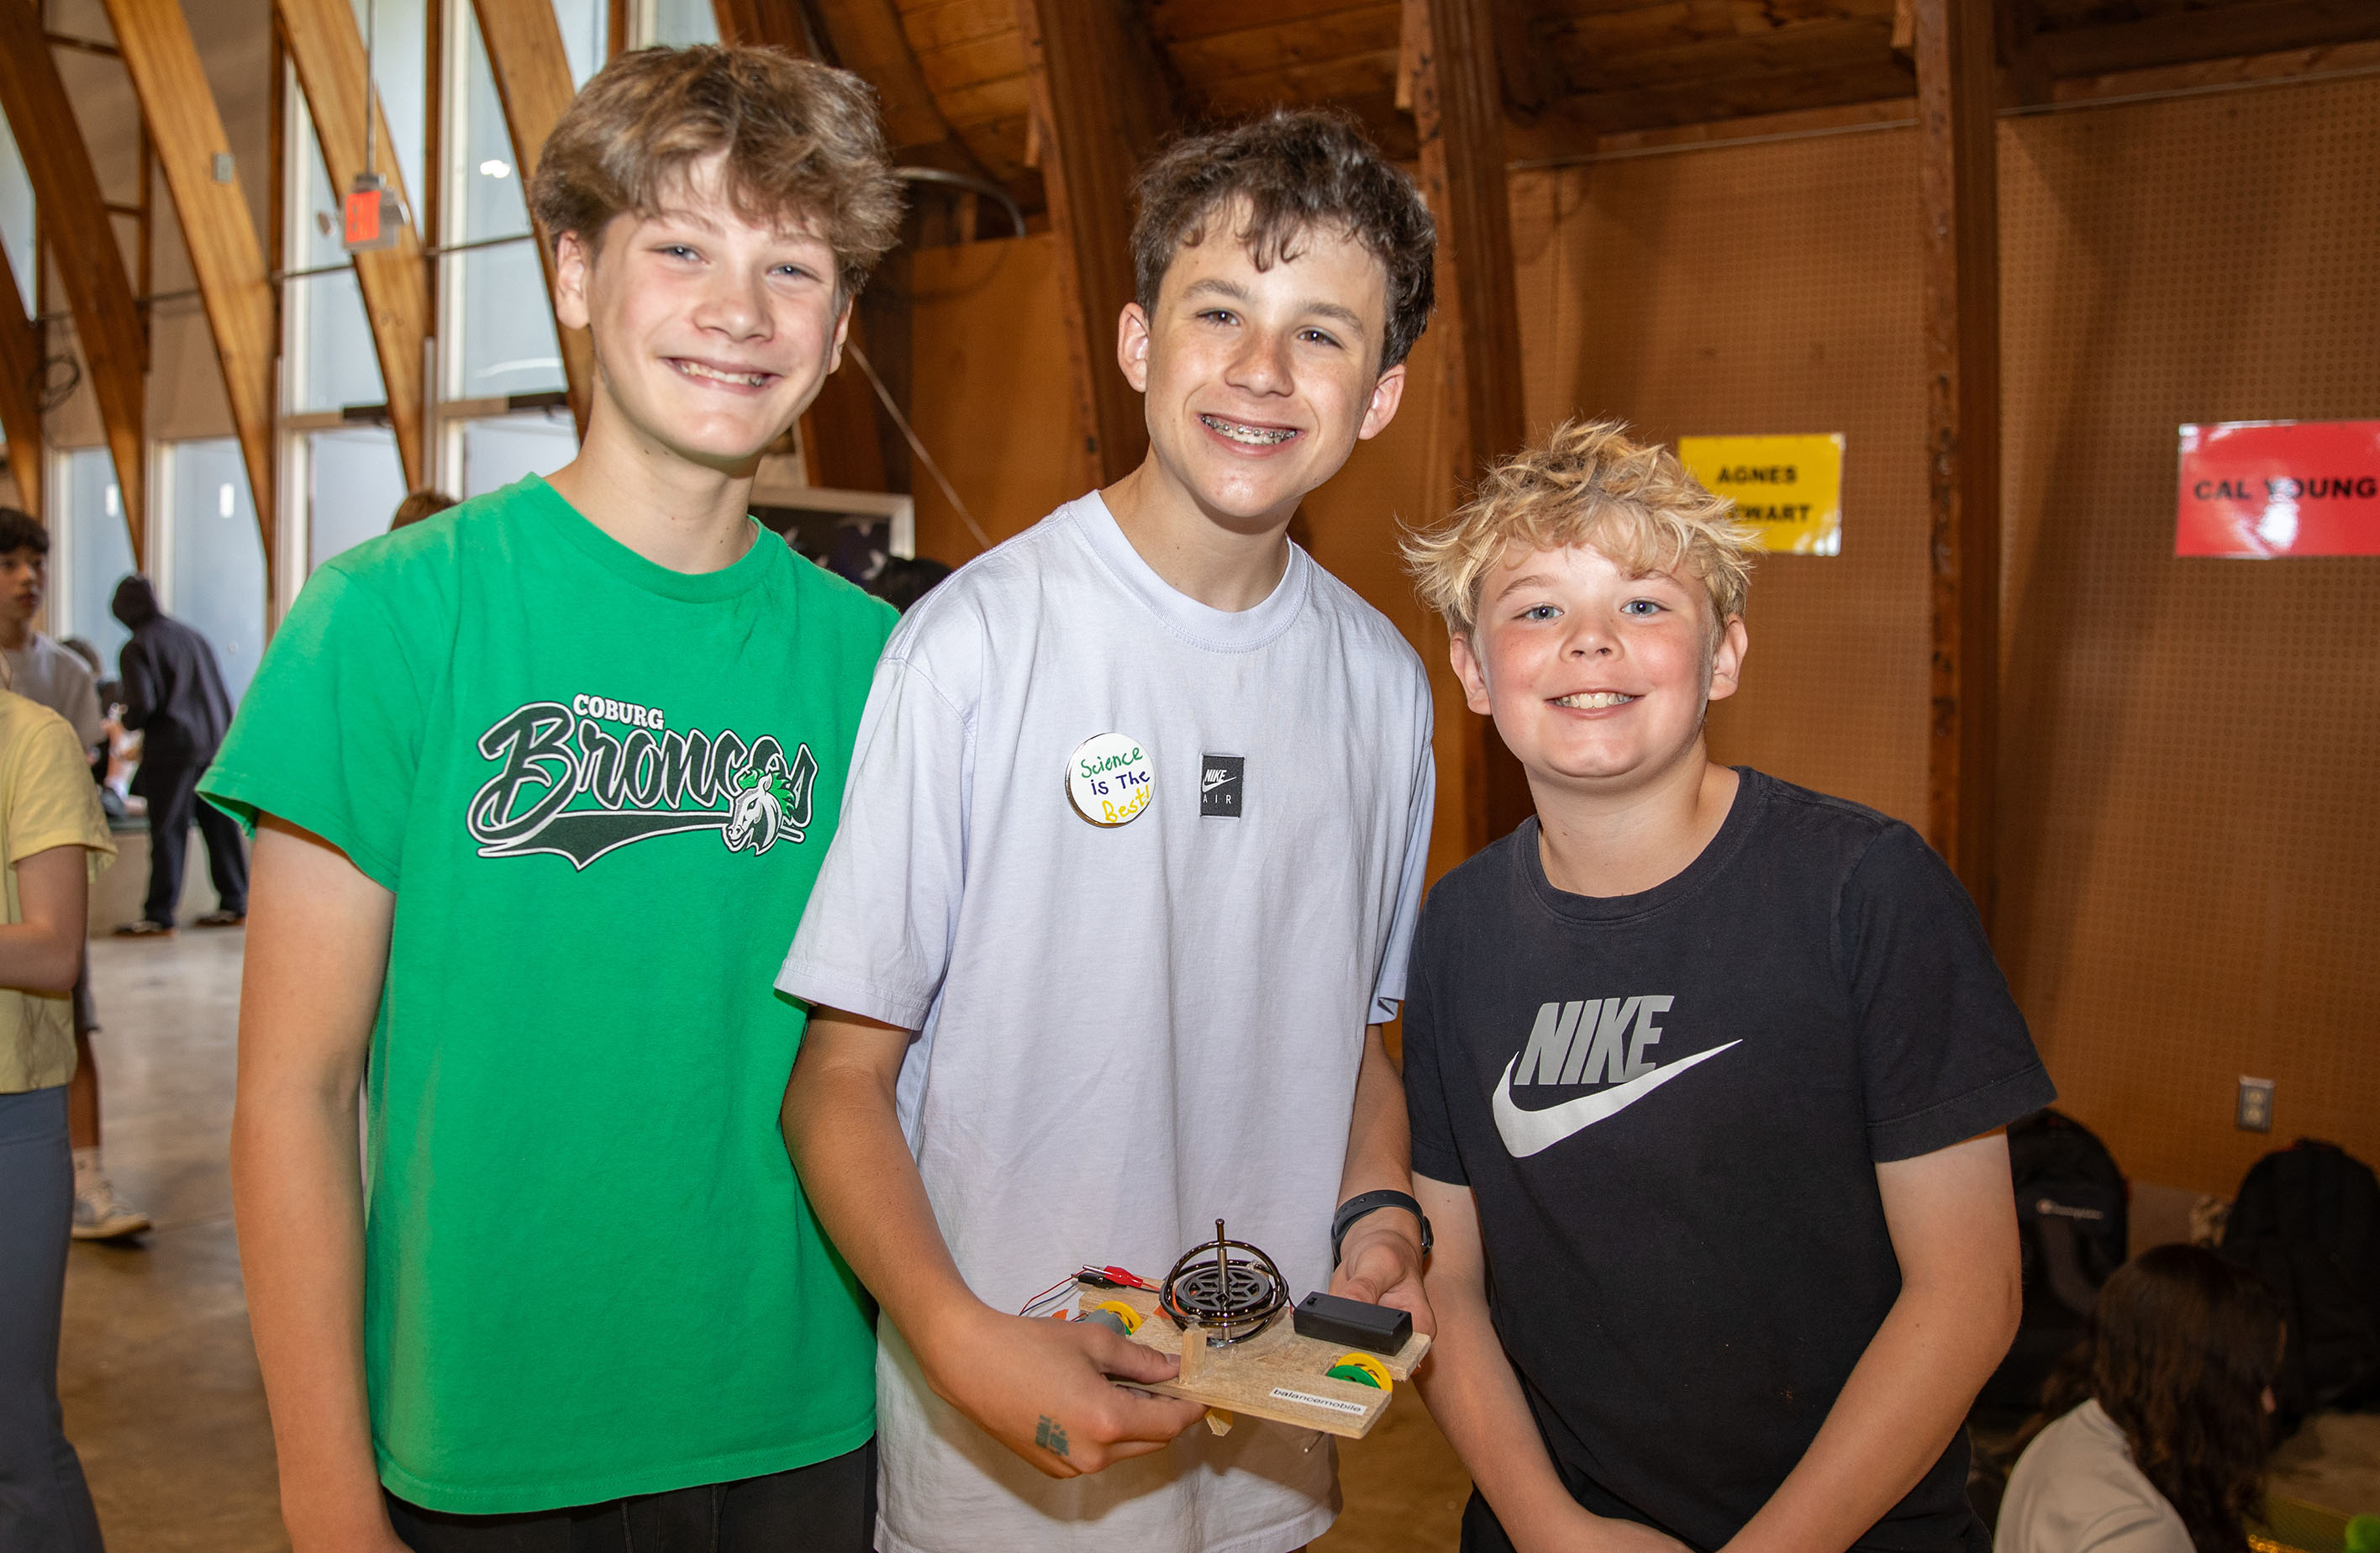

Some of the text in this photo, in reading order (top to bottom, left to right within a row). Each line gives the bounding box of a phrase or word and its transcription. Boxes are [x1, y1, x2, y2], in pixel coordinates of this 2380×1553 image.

[1717, 466, 1798, 485] AGNES
[2194, 480, 2252, 501] CAL
[572, 692, 665, 731] COBURG
[1081, 746, 1144, 778] Science
[1091, 770, 1151, 795] is The
[1203, 768, 1228, 783] NIKE
[1102, 784, 1151, 824] Best!
[1203, 793, 1232, 804] AIR
[1514, 995, 1675, 1086] NIKE
[1273, 1388, 1361, 1412] balancemobile
